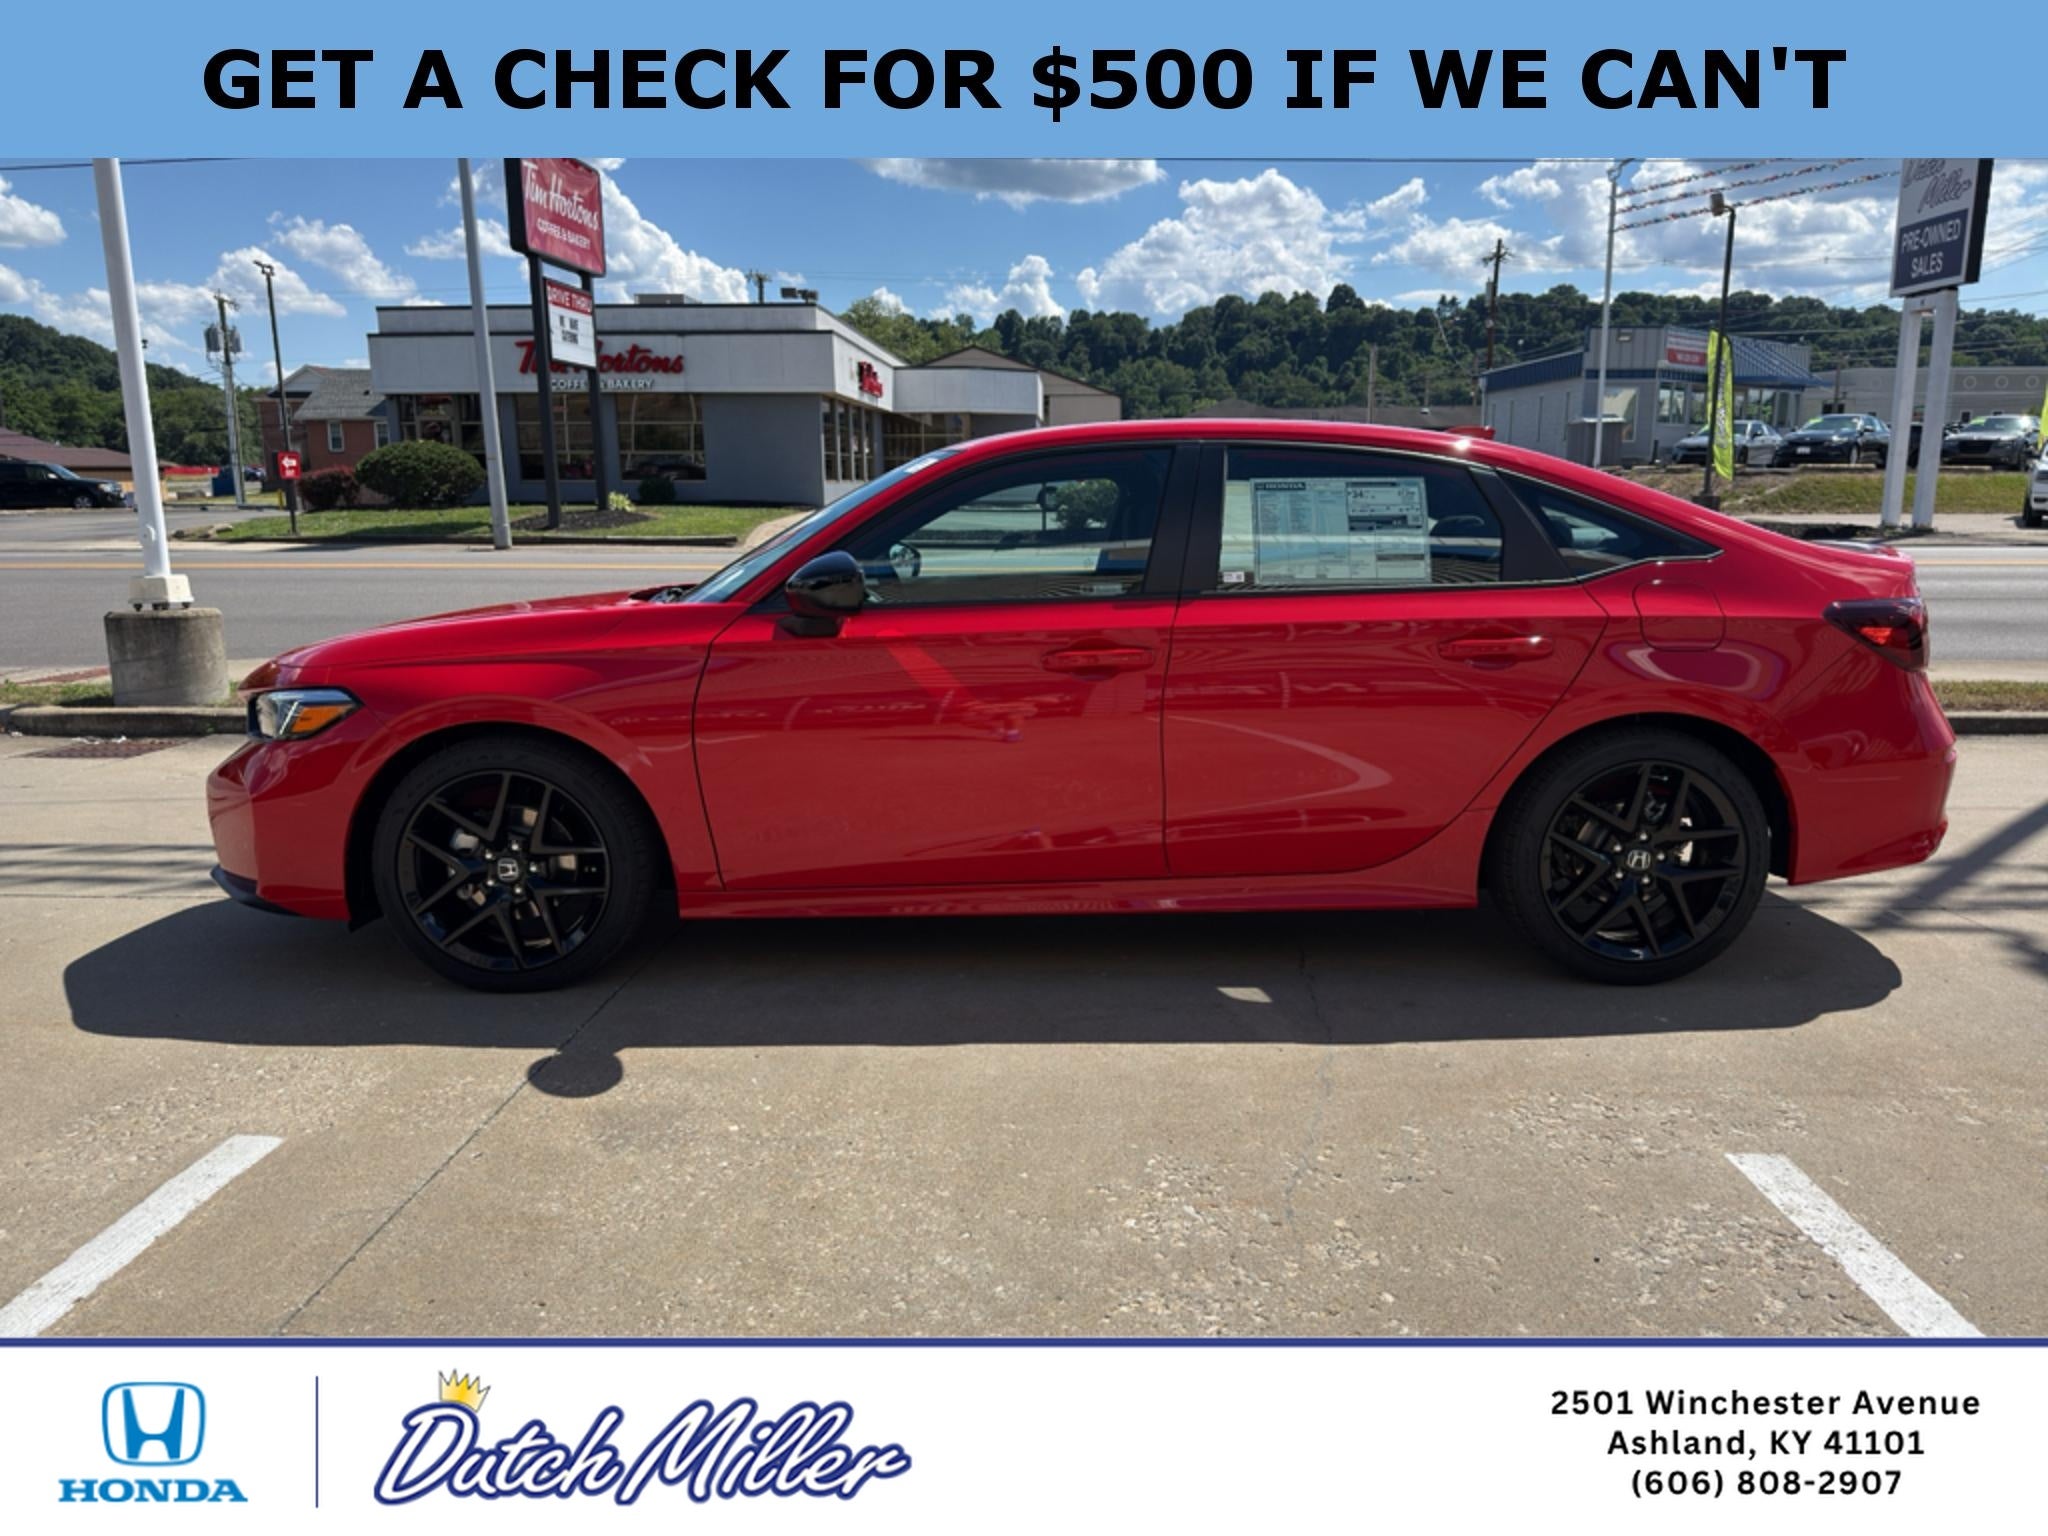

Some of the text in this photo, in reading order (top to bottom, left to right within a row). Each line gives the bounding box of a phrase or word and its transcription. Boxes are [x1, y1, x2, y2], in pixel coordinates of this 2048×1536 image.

[522, 160, 600, 231] Tim Hortons
[1901, 218, 1961, 253] PRE-OWNED
[1911, 251, 1944, 279] SALES
[546, 285, 571, 307] DRIVE
[607, 378, 656, 391] BAKERY
